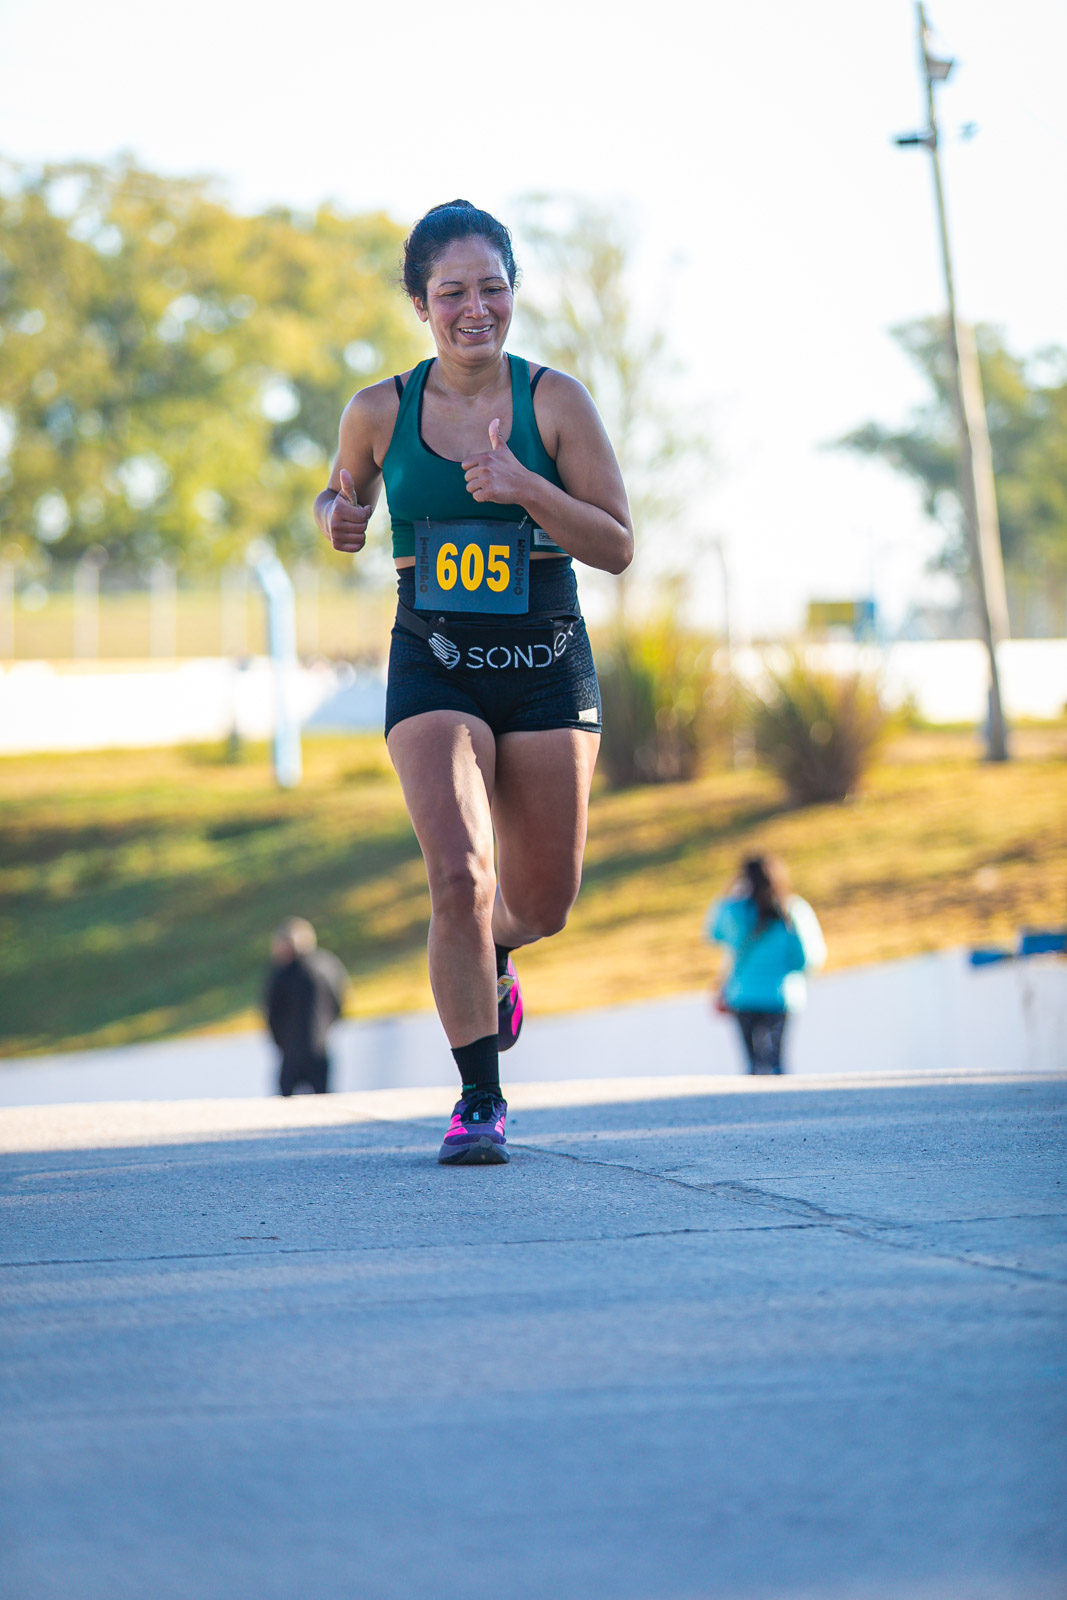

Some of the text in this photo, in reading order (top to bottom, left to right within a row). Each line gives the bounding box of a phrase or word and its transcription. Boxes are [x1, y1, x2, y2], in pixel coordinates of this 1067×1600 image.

[419, 537, 429, 593] TIEMPO
[436, 542, 511, 593] 605
[513, 539, 526, 596] EXACTO
